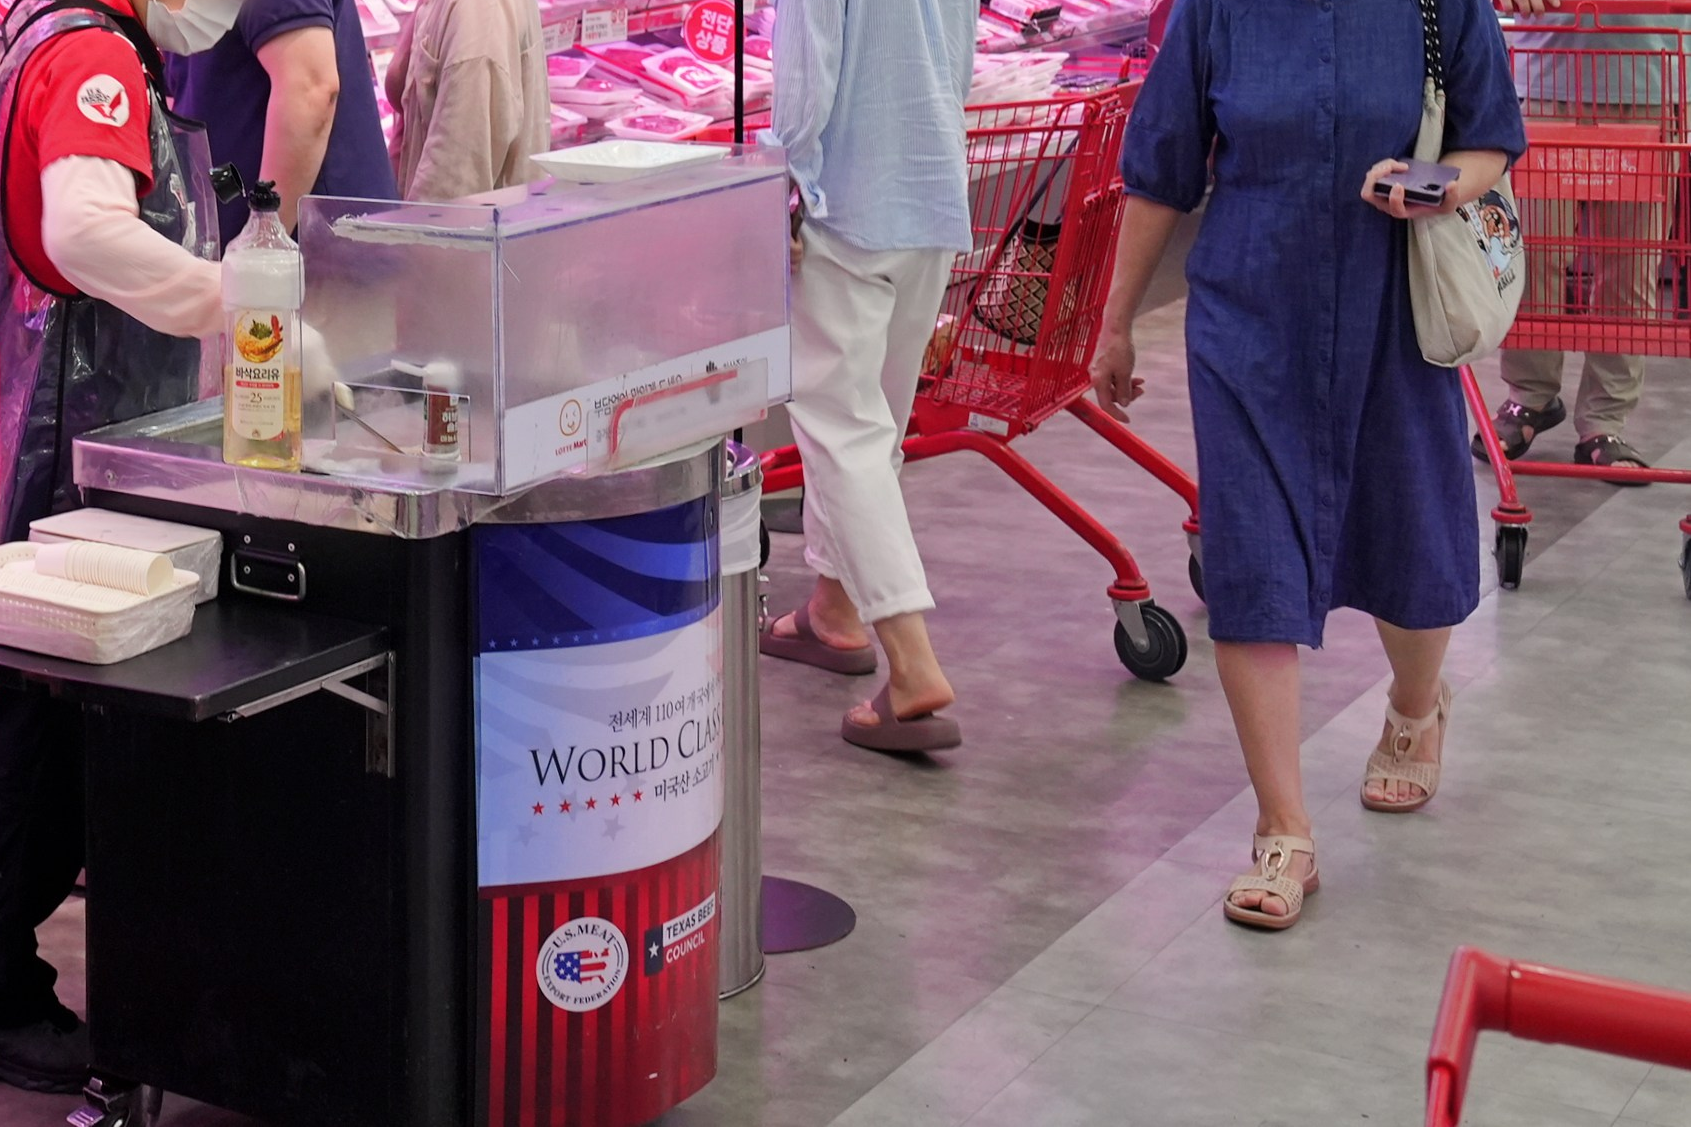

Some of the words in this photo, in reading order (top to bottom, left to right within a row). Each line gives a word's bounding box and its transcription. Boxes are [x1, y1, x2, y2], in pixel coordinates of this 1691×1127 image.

[700, 8, 734, 35] 전단
[695, 29, 728, 56] 상품
[235, 366, 280, 381] 바삭요리유
[250, 392, 263, 404] 25
[554, 444, 573, 457] LOTTE
[573, 437, 588, 450] Mart
[609, 707, 652, 733] 전세계
[529, 735, 671, 787] WORLD
[654, 770, 691, 802] 미국산
[666, 913, 697, 940] TEXAS
[697, 898, 716, 923] BEEF
[665, 932, 706, 964] COUNCIL
[543, 974, 572, 1005] EXPORT
[572, 967, 622, 1005] FEDERATION
